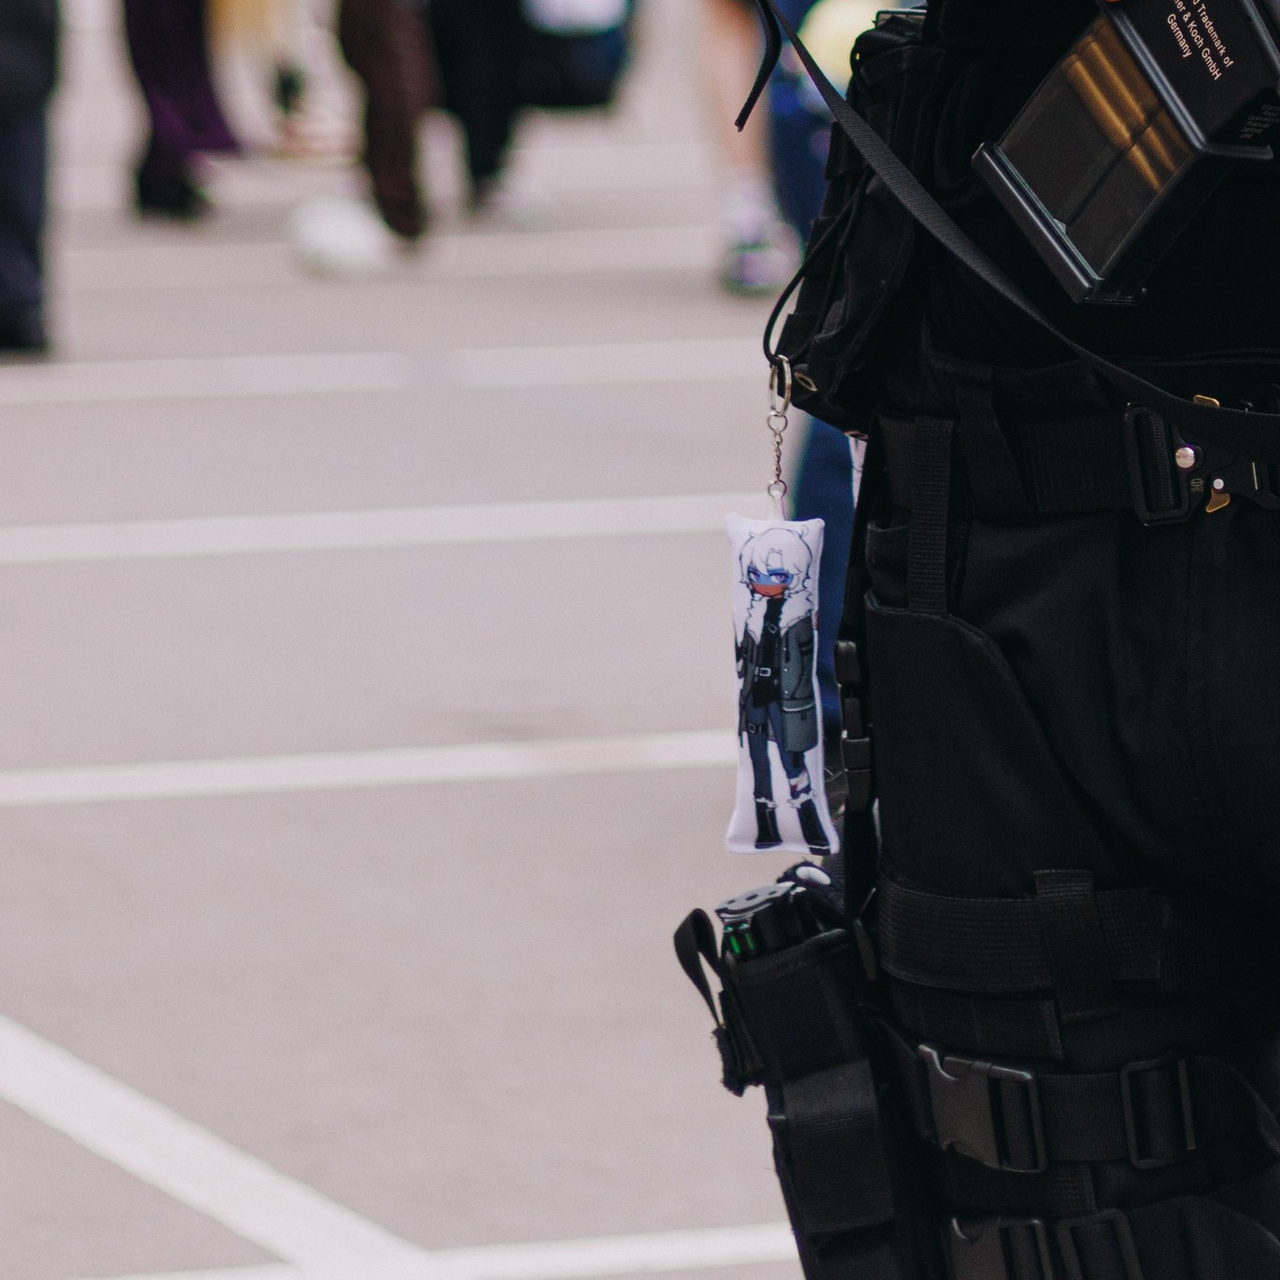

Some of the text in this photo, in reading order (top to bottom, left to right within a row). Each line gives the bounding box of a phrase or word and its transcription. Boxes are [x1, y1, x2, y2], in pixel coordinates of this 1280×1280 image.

[1167, 13, 1193, 59] Germany
[1182, 11, 1192, 23] &
[1187, 20, 1204, 49] Koch
[1201, 47, 1222, 81] GmbH
[1197, 3, 1228, 57] Trademark
[1223, 56, 1235, 68] of
